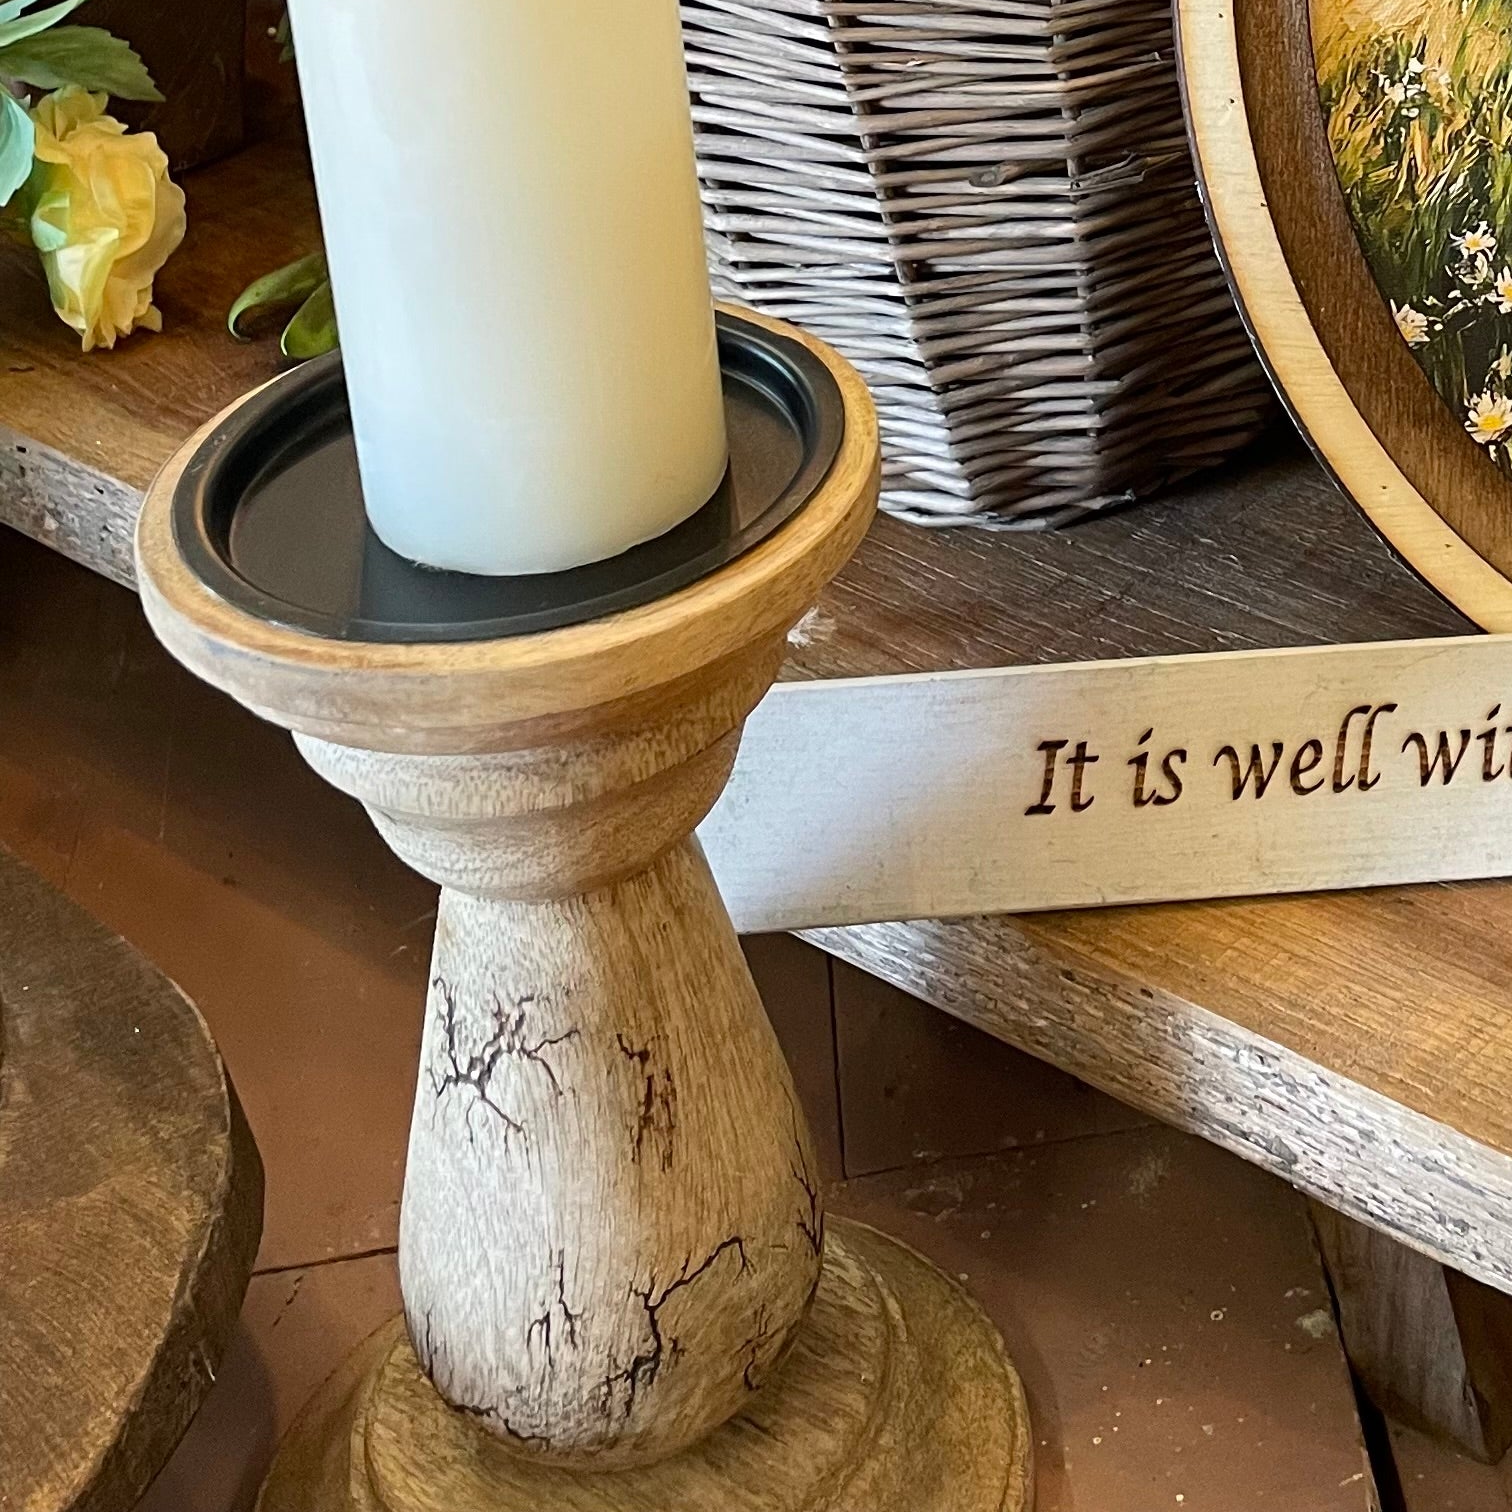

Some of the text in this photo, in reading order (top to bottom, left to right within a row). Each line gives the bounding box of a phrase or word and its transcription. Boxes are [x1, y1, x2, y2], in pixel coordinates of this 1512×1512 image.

[1024, 738, 1099, 817] It
[1127, 727, 1188, 809] is
[1212, 702, 1399, 801] well
